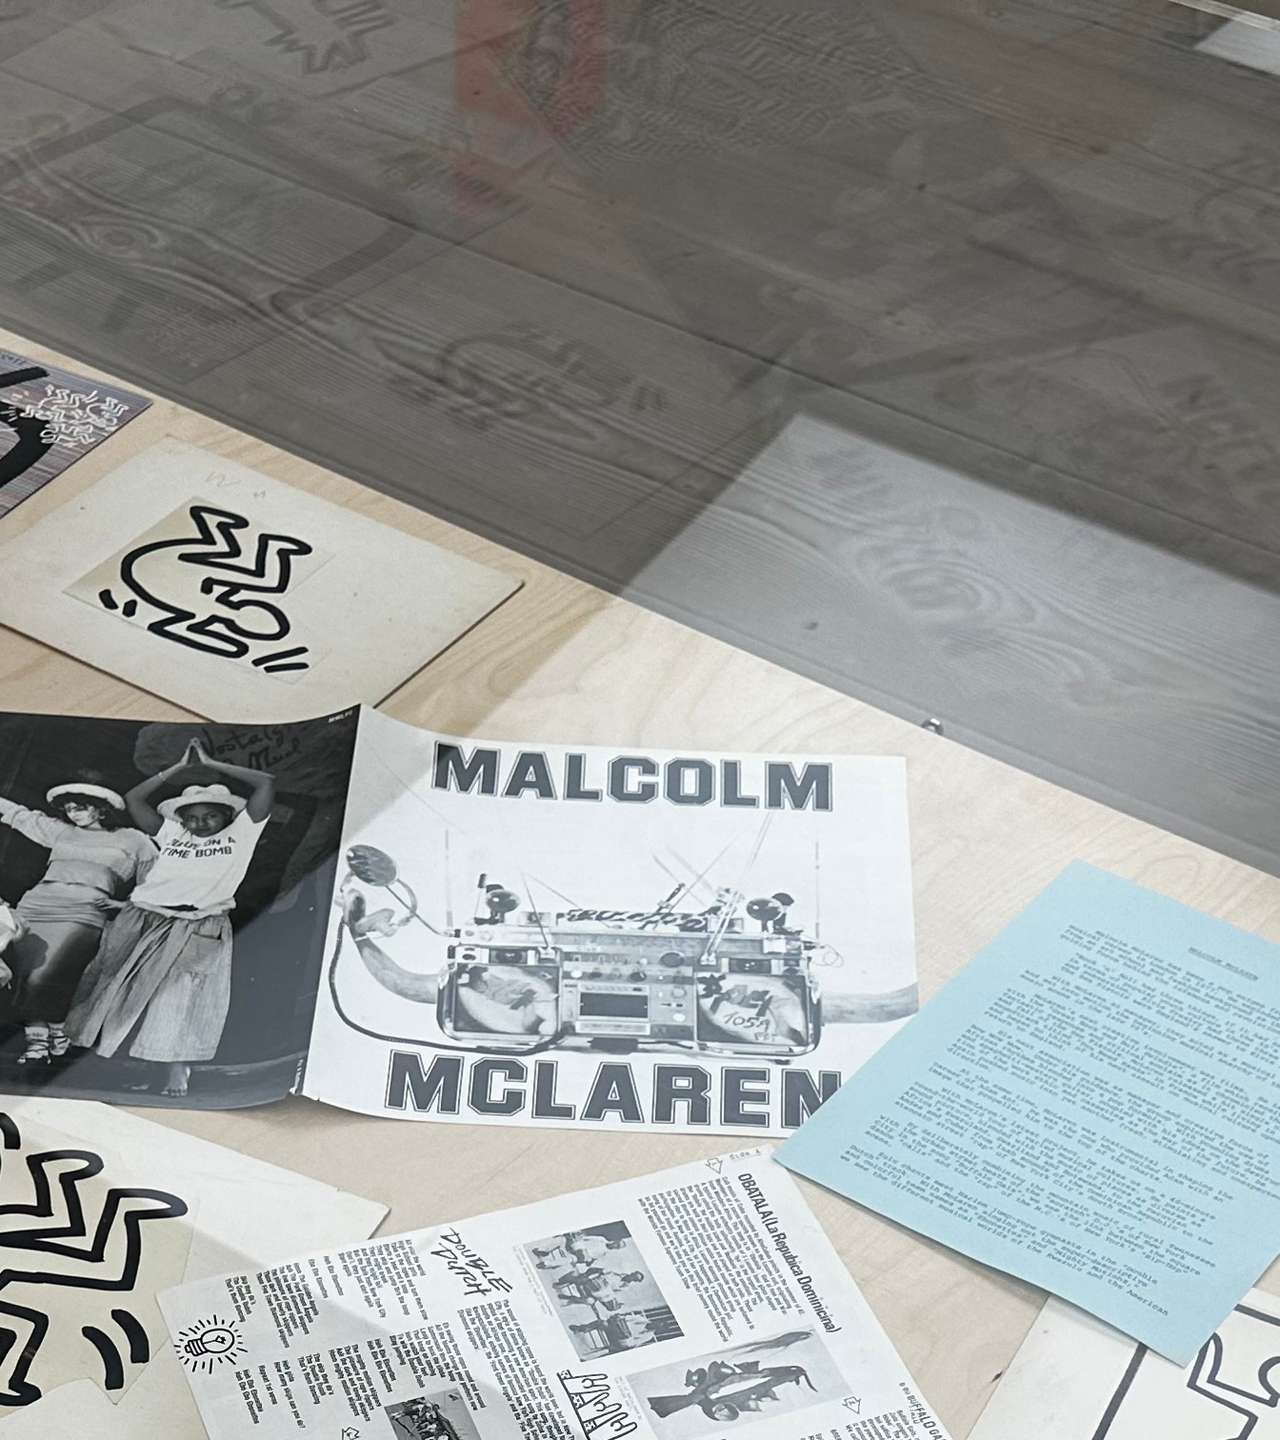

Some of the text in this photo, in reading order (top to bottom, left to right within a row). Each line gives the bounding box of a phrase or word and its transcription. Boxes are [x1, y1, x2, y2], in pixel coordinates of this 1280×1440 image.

[432, 740, 833, 811] MALCOLM
[162, 847, 232, 858] TIME BOMB
[384, 1050, 841, 1128] MCLAREN
[430, 1242, 492, 1296] DUTCH
[440, 1227, 513, 1293] DOUBLE
[1126, 1288, 1169, 1316] American
